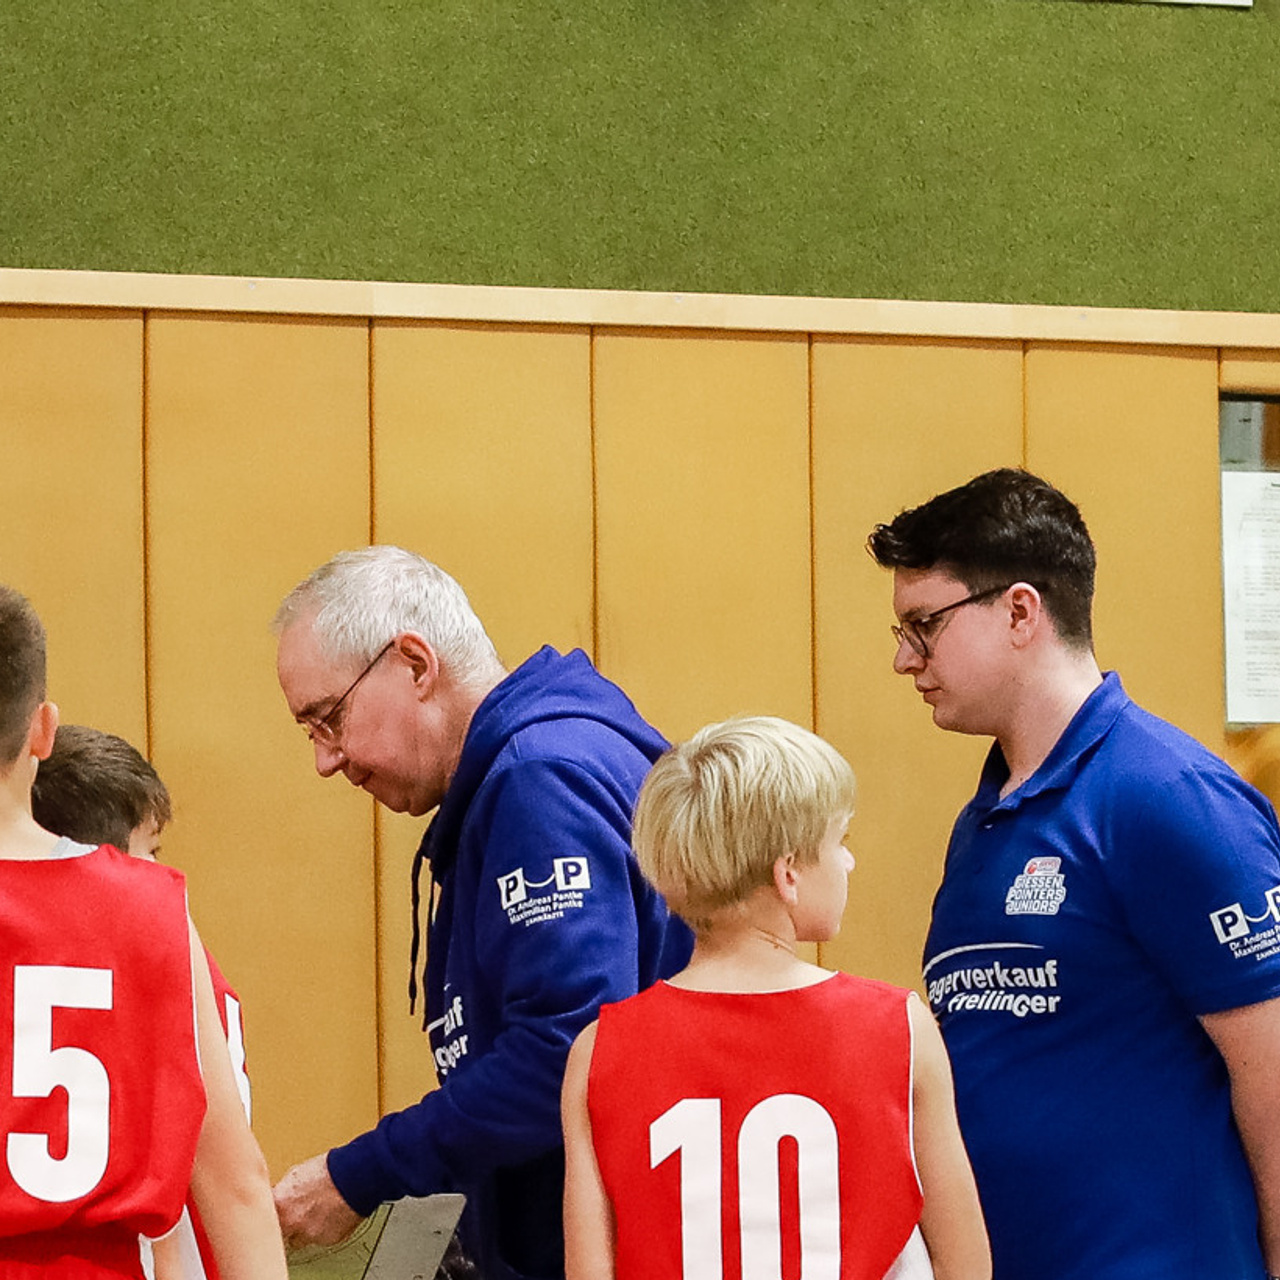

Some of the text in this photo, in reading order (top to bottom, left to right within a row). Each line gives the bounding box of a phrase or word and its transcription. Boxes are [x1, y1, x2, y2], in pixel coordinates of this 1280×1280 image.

[1007, 887, 1065, 901] POINTERS
[517, 895, 552, 912] Andreas
[1006, 900, 1059, 913] JUNIORS
[1243, 928, 1276, 948] Andreas
[927, 959, 1058, 1006] agerverkauf
